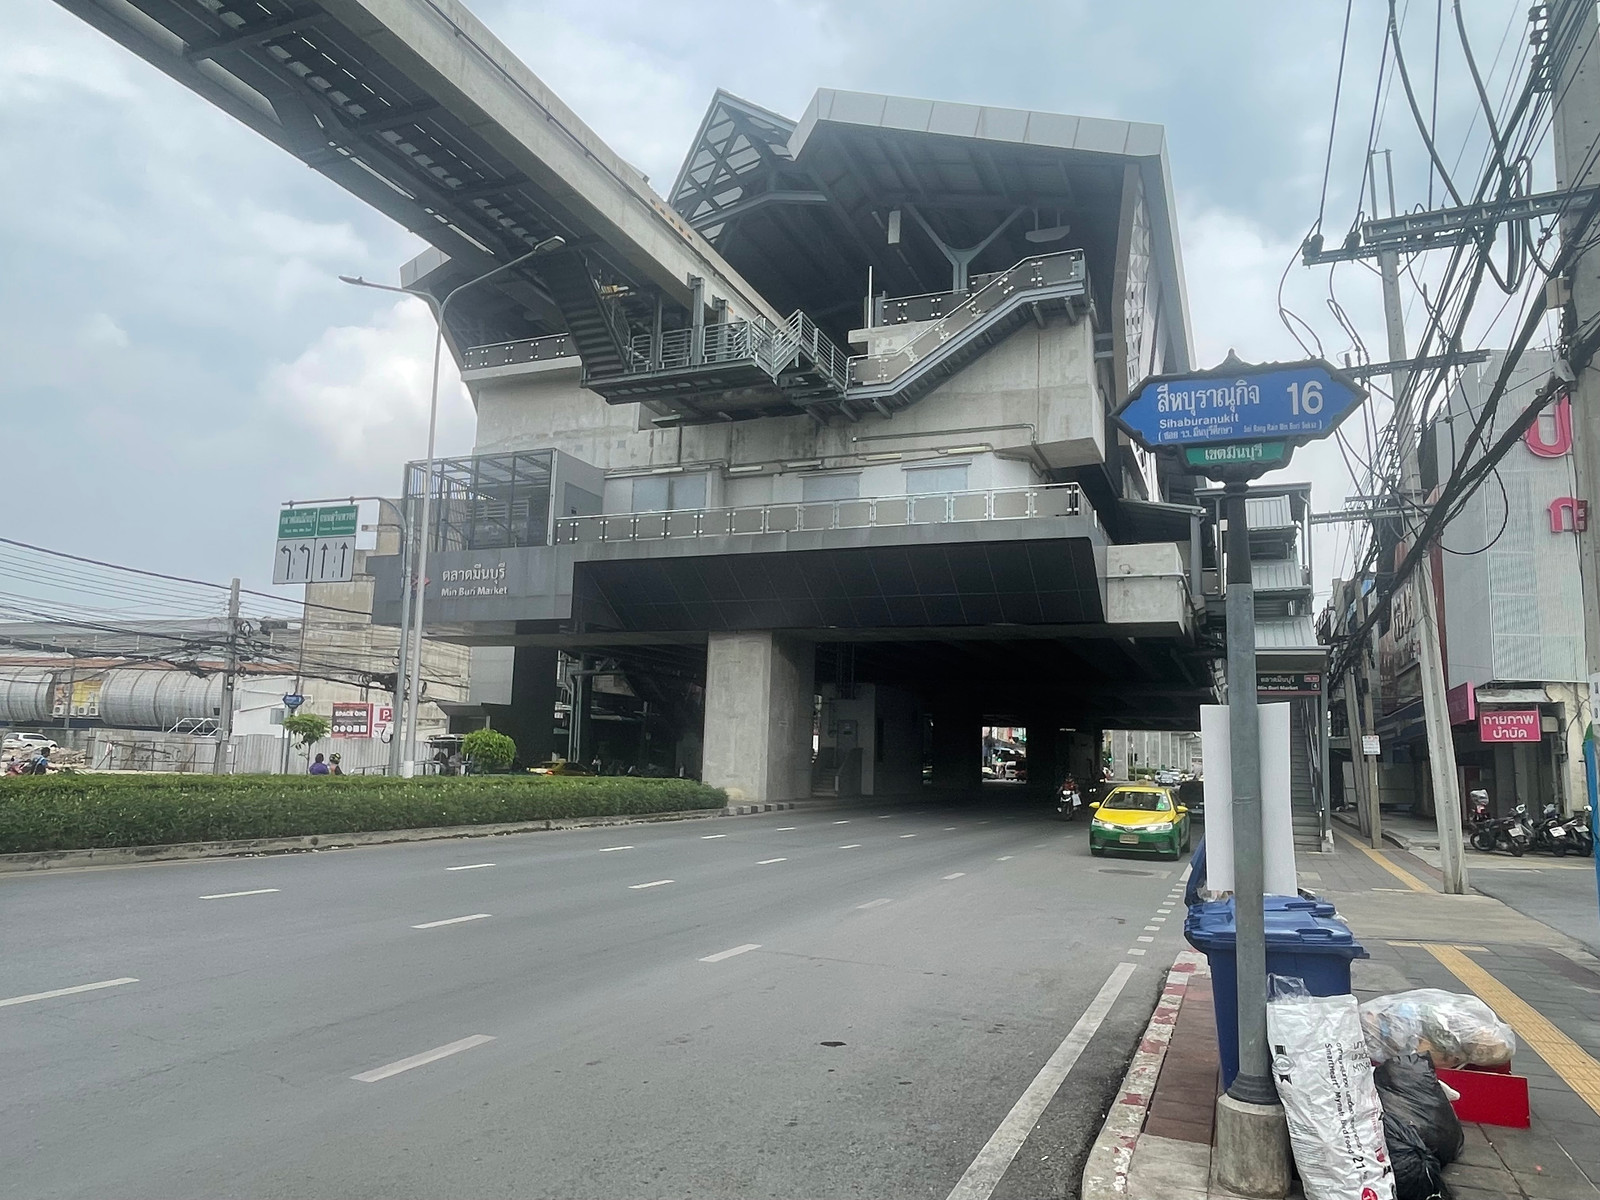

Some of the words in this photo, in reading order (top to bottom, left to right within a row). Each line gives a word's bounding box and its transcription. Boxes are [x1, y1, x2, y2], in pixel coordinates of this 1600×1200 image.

[1157, 379, 1260, 416] สีหบุราณุกิจ
[1286, 380, 1323, 415] 16
[1159, 412, 1239, 429] Sihaburanukit
[1204, 443, 1263, 461] เขตมีนบุรี
[442, 562, 506, 585] ตลาดมีนบุรี
[441, 587, 458, 597] Min
[459, 586, 476, 597] Buri
[477, 585, 508, 596] Market
[1483, 715, 1534, 725] กายภาพ
[1492, 726, 1528, 739] บำบัด
[1352, 1156, 1366, 1170] 21
